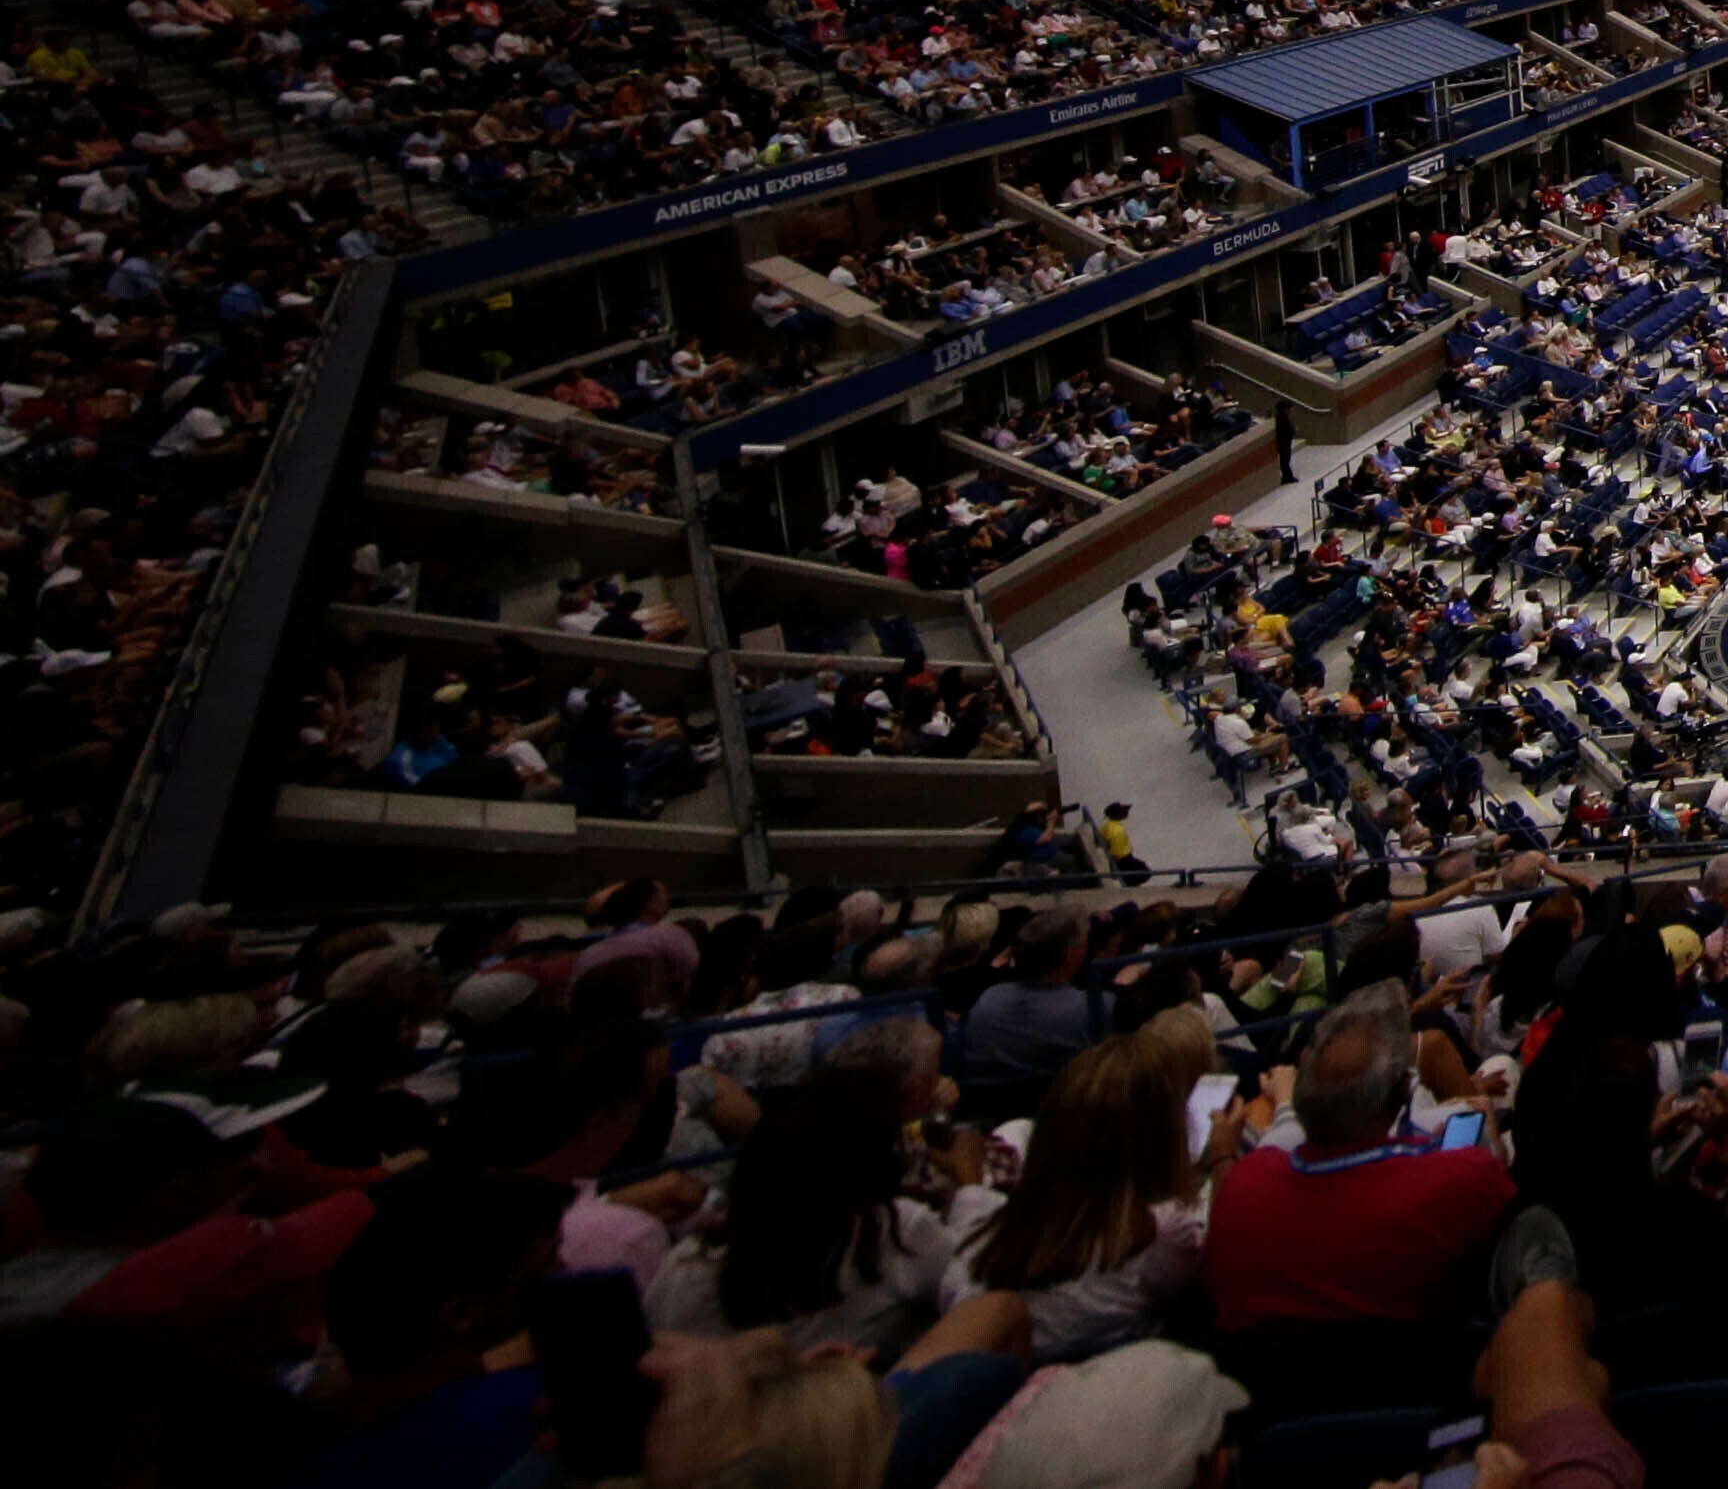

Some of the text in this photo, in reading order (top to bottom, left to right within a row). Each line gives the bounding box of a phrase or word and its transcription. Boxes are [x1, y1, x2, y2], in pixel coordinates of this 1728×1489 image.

[1049, 91, 1137, 124] Emirates Airline
[1408, 153, 1445, 180] ESPN
[654, 161, 848, 224] AMERICAN EXPRESS
[1213, 221, 1280, 257] BERMUDA
[932, 329, 987, 373] IBM
